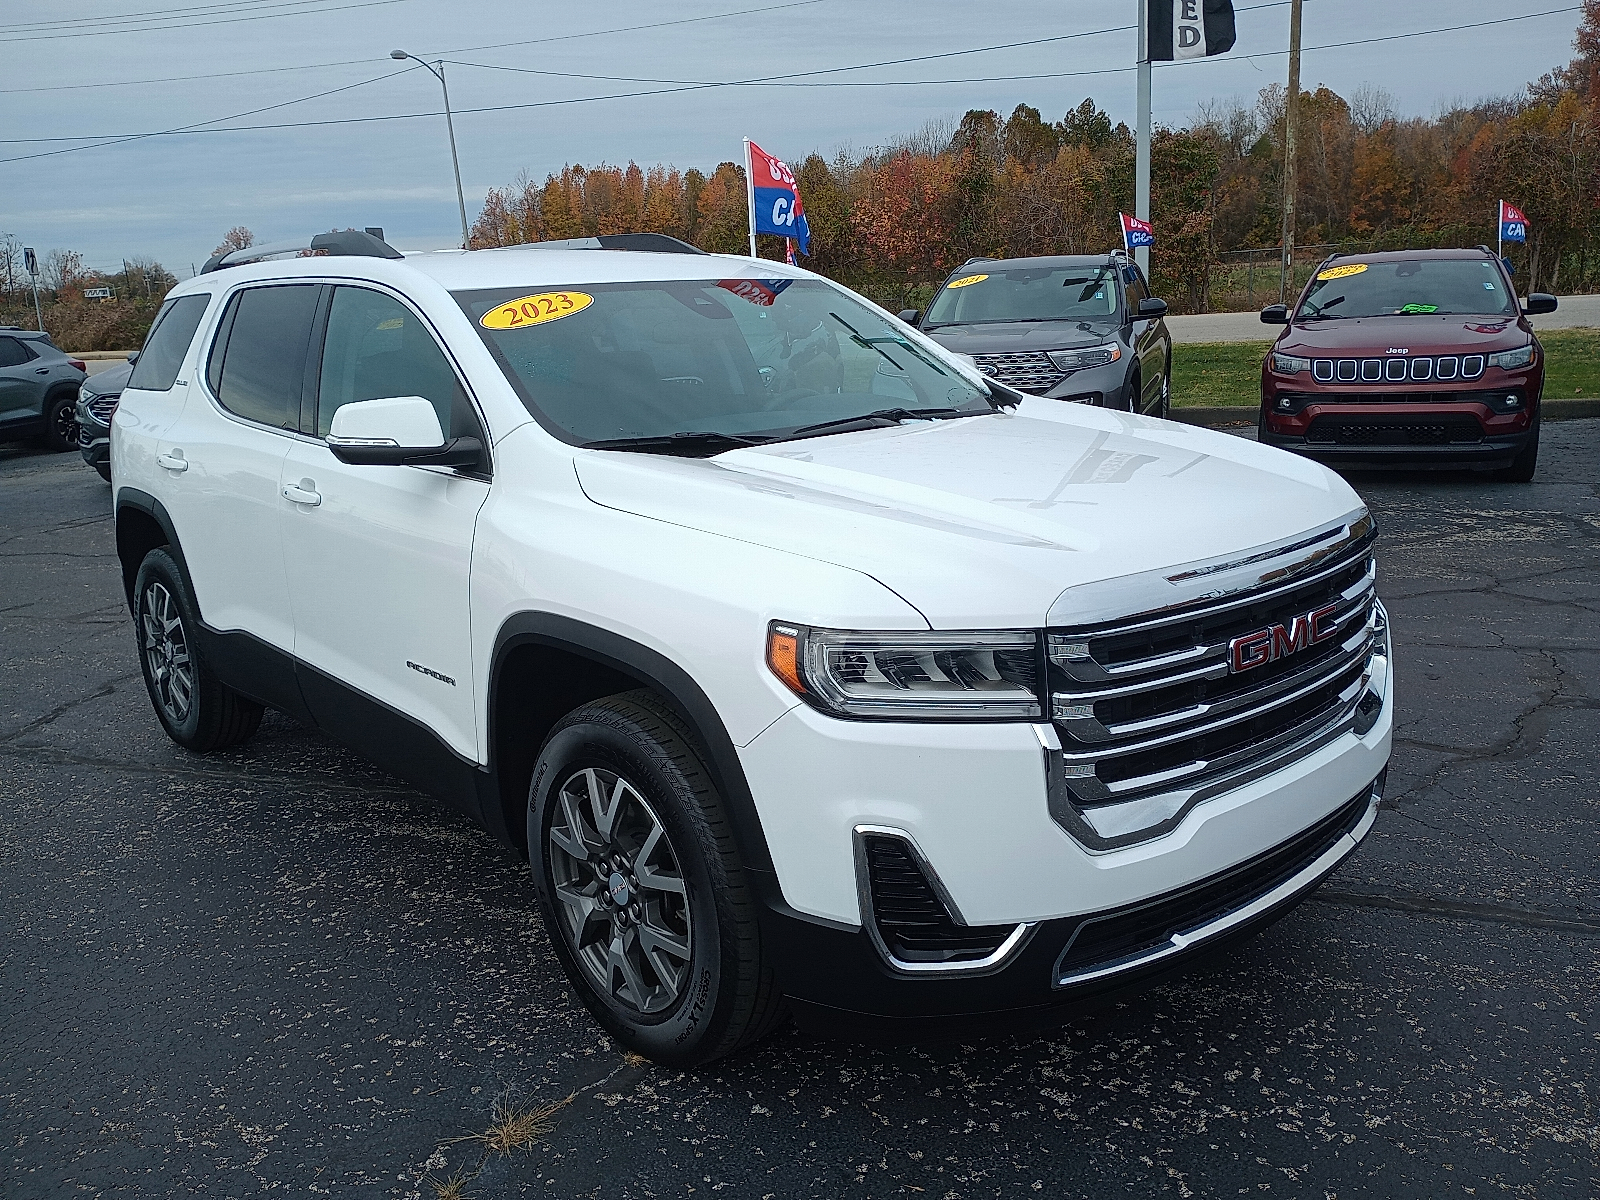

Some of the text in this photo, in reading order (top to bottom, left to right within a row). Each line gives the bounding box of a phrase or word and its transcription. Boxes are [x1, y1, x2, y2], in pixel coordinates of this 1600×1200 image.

[502, 294, 574, 325] 2023
[1385, 347, 1409, 355] Jeep
[1229, 605, 1338, 675] GMC
[406, 660, 457, 687] ACADIA
[700, 969, 711, 1006] CROSS
[688, 1001, 703, 1027] LX
